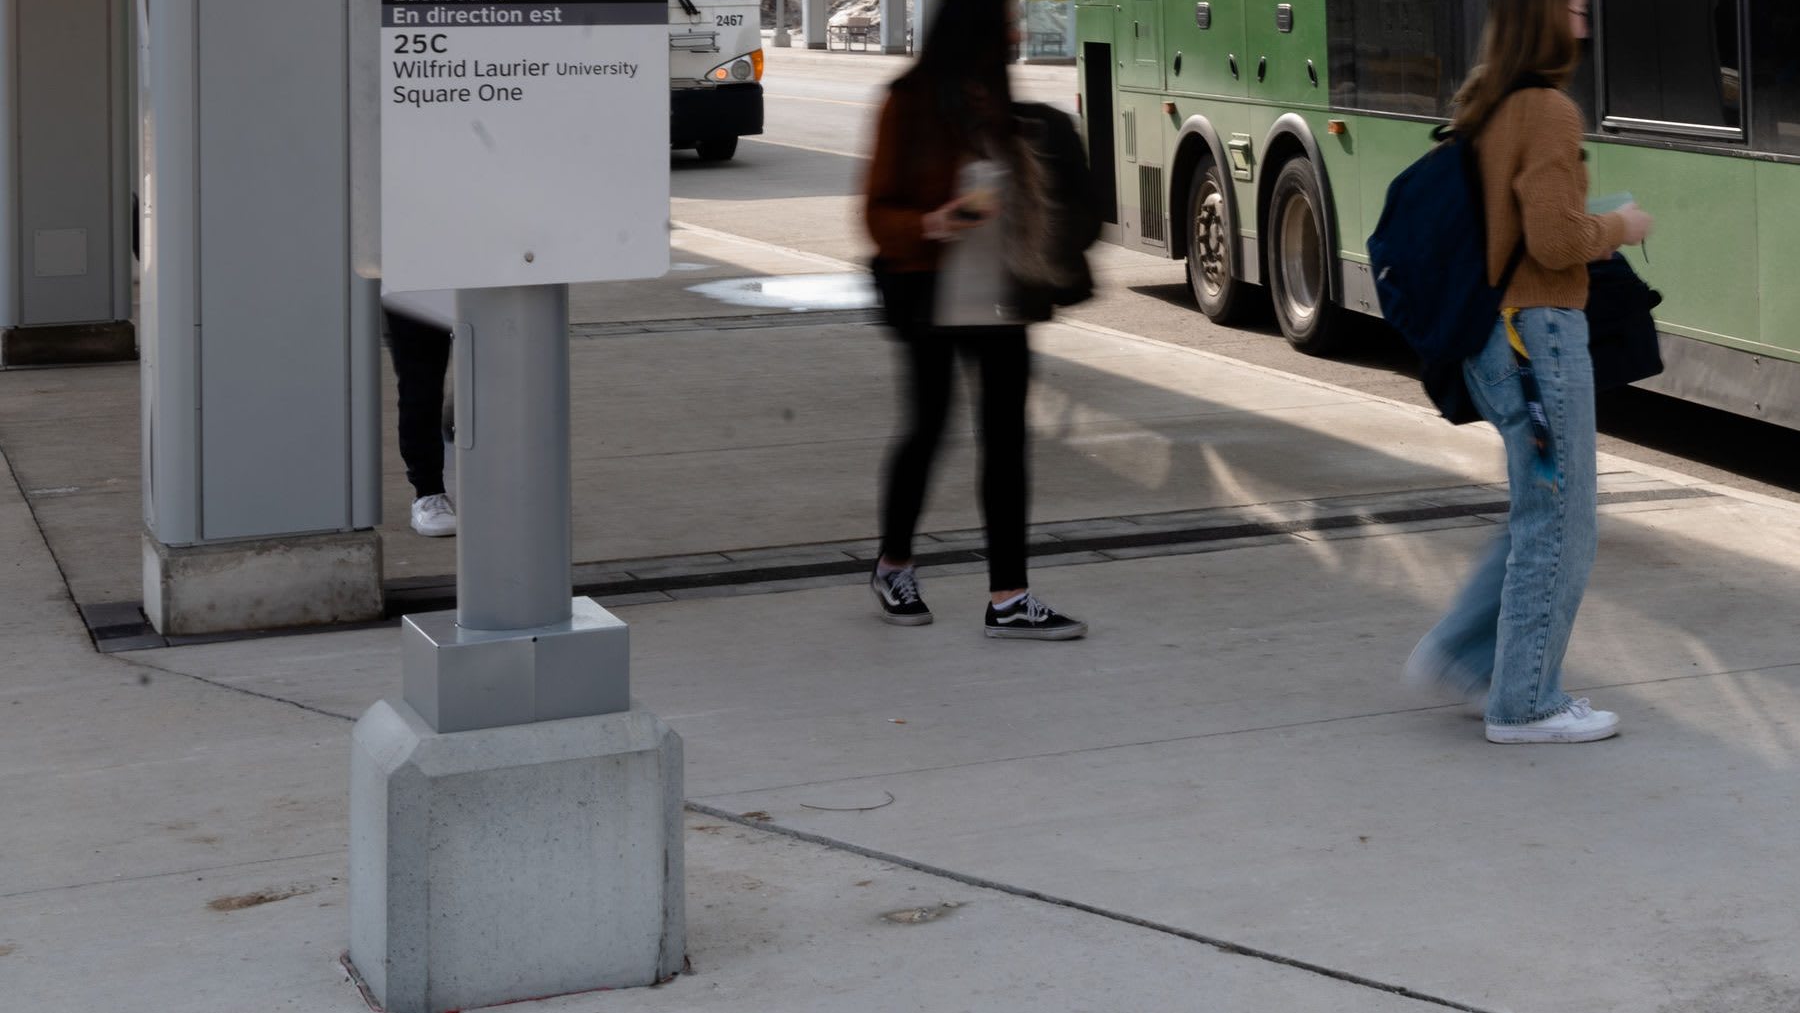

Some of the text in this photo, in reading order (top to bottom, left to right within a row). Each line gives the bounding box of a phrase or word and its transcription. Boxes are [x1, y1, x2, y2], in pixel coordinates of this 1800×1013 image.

[392, 6, 562, 24] En direction est
[716, 15, 744, 27] 2467
[393, 33, 448, 55] 25C
[393, 59, 638, 79] Wilfrid Laurier University
[393, 84, 523, 108] Square One
